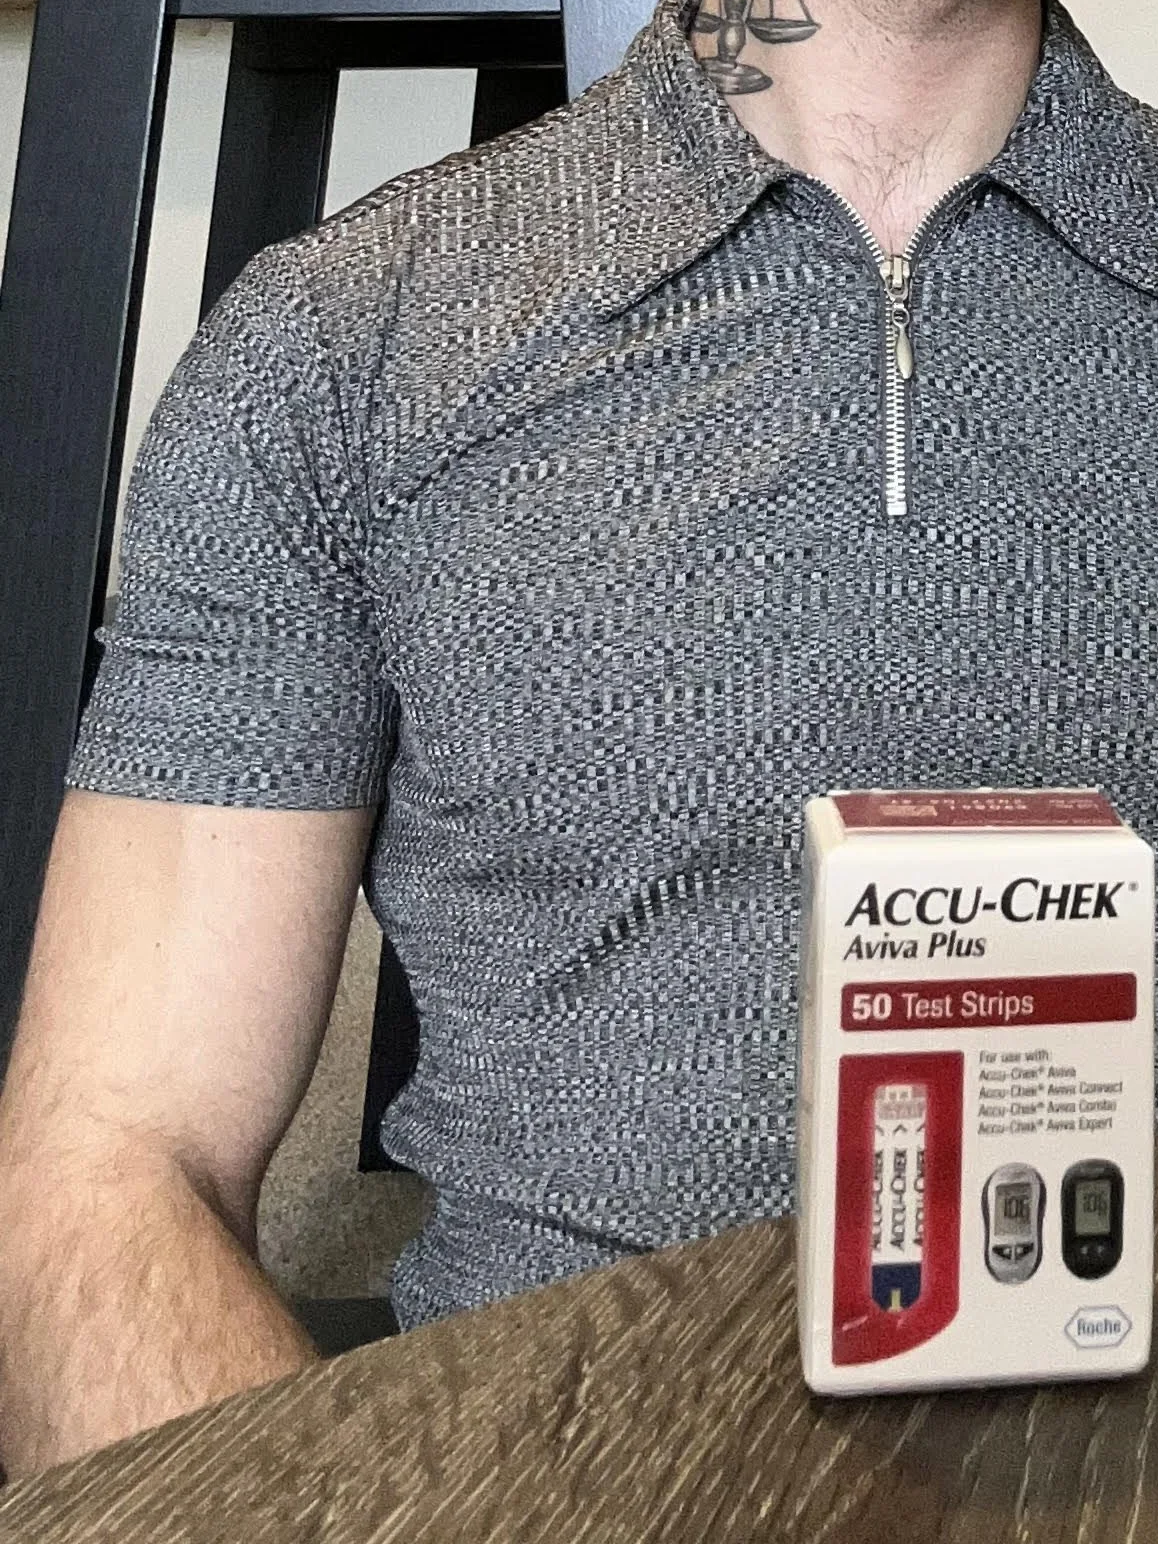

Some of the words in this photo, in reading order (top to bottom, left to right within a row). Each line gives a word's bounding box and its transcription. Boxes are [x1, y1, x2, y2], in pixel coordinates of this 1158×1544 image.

[843, 932, 919, 961] Aviva
[927, 930, 987, 958] Plus
[851, 991, 893, 1021] 50
[901, 991, 953, 1020] Test
[961, 989, 1035, 1022] Strips
[979, 1049, 998, 1063] For
[1001, 1051, 1022, 1063] use
[1047, 1065, 1077, 1078] Aviva
[1077, 1317, 1122, 1336] Roche
